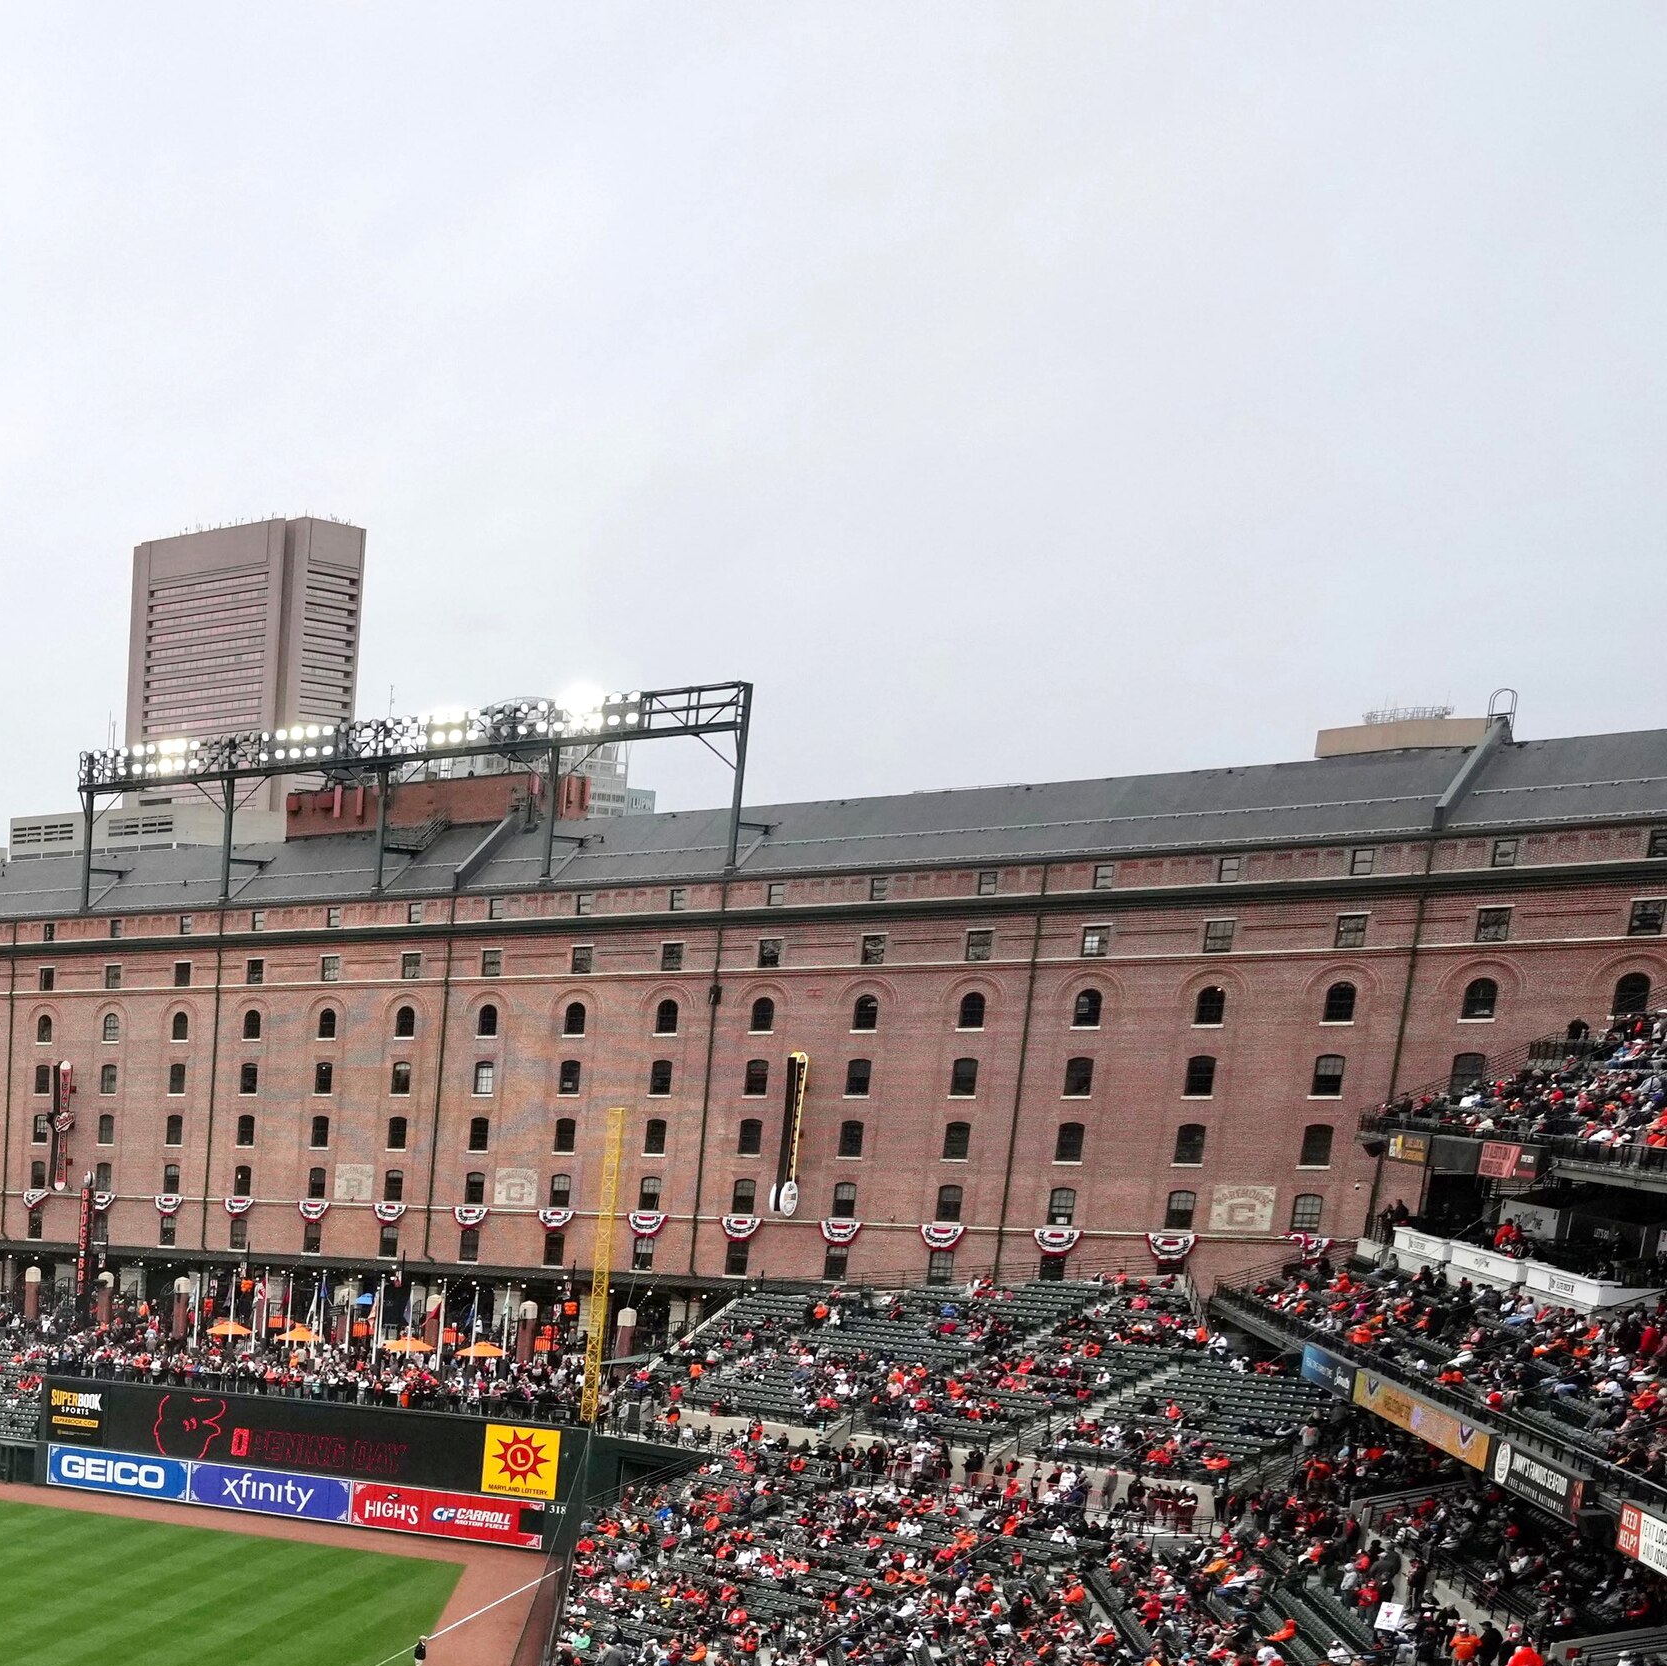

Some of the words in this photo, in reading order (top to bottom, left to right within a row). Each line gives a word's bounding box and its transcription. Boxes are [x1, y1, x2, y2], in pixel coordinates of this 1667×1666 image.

[51, 1388, 102, 1411] SUPERBOOK
[61, 1406, 89, 1416] SPORTS
[53, 1416, 98, 1428] SUPERBOOK.COM
[61, 1455, 165, 1489] GEICO
[222, 1473, 316, 1513] xfinity
[488, 1483, 520, 1494] MARYLAND
[364, 1500, 419, 1525] HIGH'S
[456, 1508, 511, 1525] CARROLL
[549, 1505, 566, 1515] 318
[1621, 1508, 1638, 1531] NEED
[454, 1518, 484, 1528] MOTOR
[485, 1521, 510, 1531] FUELS
[1618, 1529, 1638, 1553] HELP?
